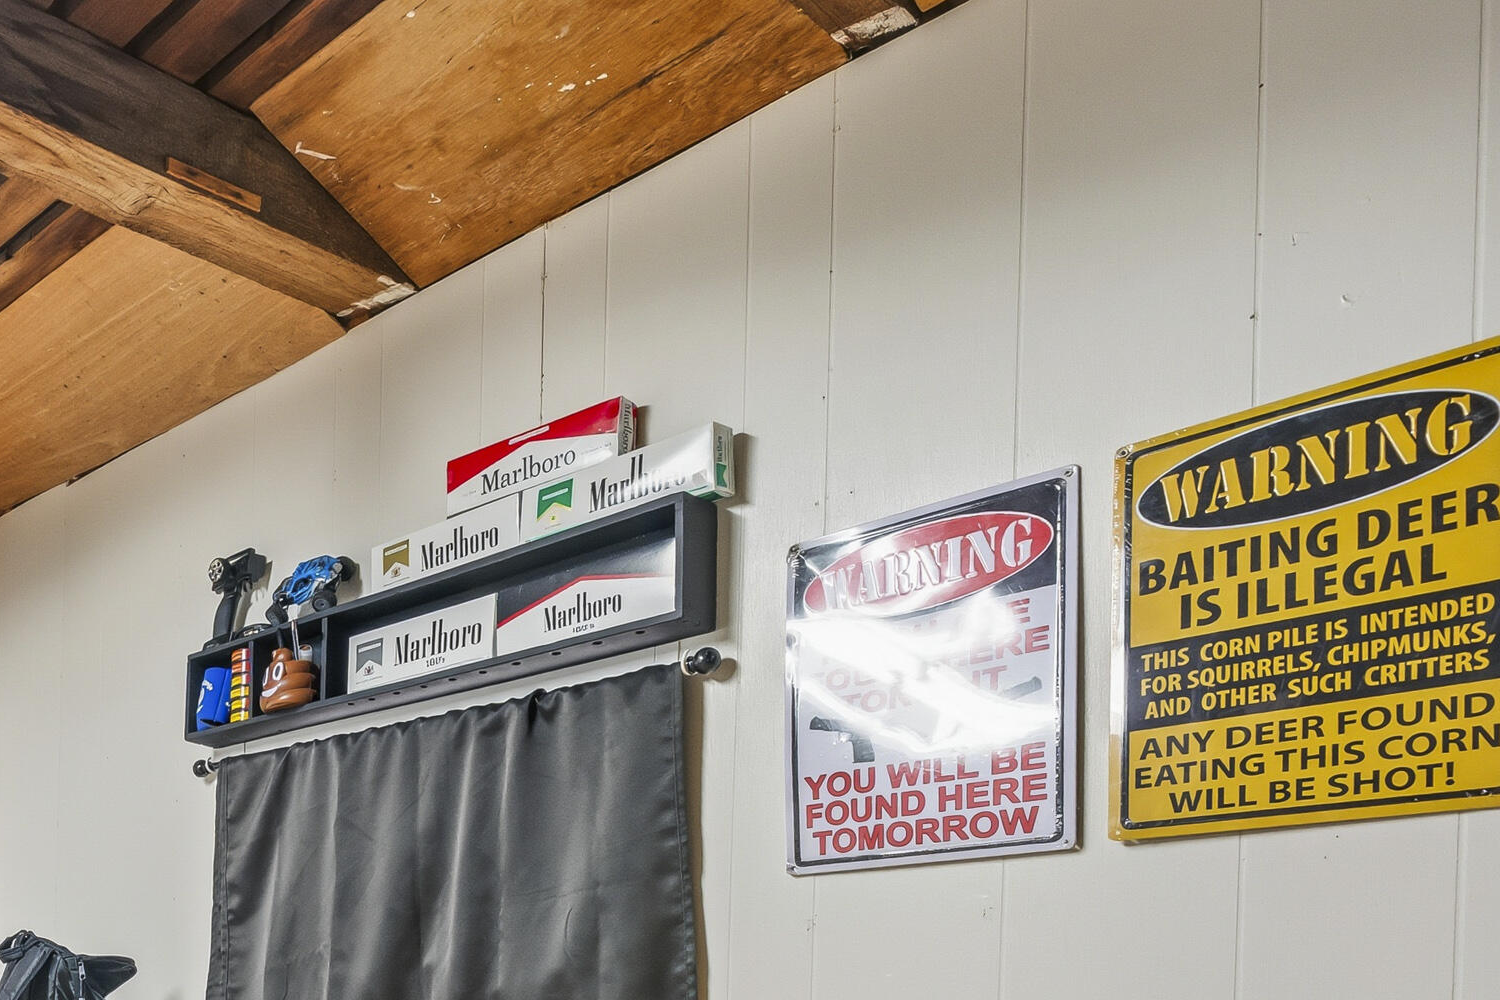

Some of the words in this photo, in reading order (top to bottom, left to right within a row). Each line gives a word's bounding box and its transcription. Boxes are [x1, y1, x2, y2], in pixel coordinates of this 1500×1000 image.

[480, 448, 576, 496] Marlboro
[1160, 394, 1473, 523] WARNING
[420, 525, 499, 572] Marlboro
[823, 517, 1033, 610] WARNING
[1139, 518, 1338, 596] BAITING
[1357, 483, 1500, 551] DEER
[543, 591, 622, 633] Marlboro
[1180, 588, 1222, 629] IS
[1237, 544, 1447, 619] ILLEGAL
[394, 618, 482, 667] Marlboro
[1140, 673, 1181, 697] FOR
[1187, 650, 1321, 687] SQUIRRELS,
[1327, 621, 1497, 666] CHIPMUNKS,
[1141, 647, 1190, 673] THIS
[1200, 634, 1261, 662] CORN
[1268, 623, 1318, 651] PILE
[1325, 618, 1349, 641] IS
[1360, 592, 1496, 635] INTENDED
[1144, 696, 1191, 720] AND
[1201, 684, 1277, 712] OTHER
[1287, 670, 1352, 699] SUCH
[1364, 648, 1490, 687] CRITTERS
[1135, 754, 1265, 789] EATING
[1275, 740, 1365, 772] THIS
[1378, 723, 1500, 760] CORN
[1139, 729, 1215, 761] ANY
[1225, 716, 1325, 750] DEER
[1337, 693, 1495, 735] FOUND
[804, 766, 875, 800] YOU
[886, 754, 979, 788] WILL
[991, 741, 1047, 775] BE
[805, 790, 926, 829] FOUND
[938, 773, 1048, 812] HERE
[1168, 785, 1257, 814] WILL
[1268, 777, 1316, 803] BE
[1327, 761, 1456, 798] SHOT!
[812, 806, 1040, 855] TOMORROW
